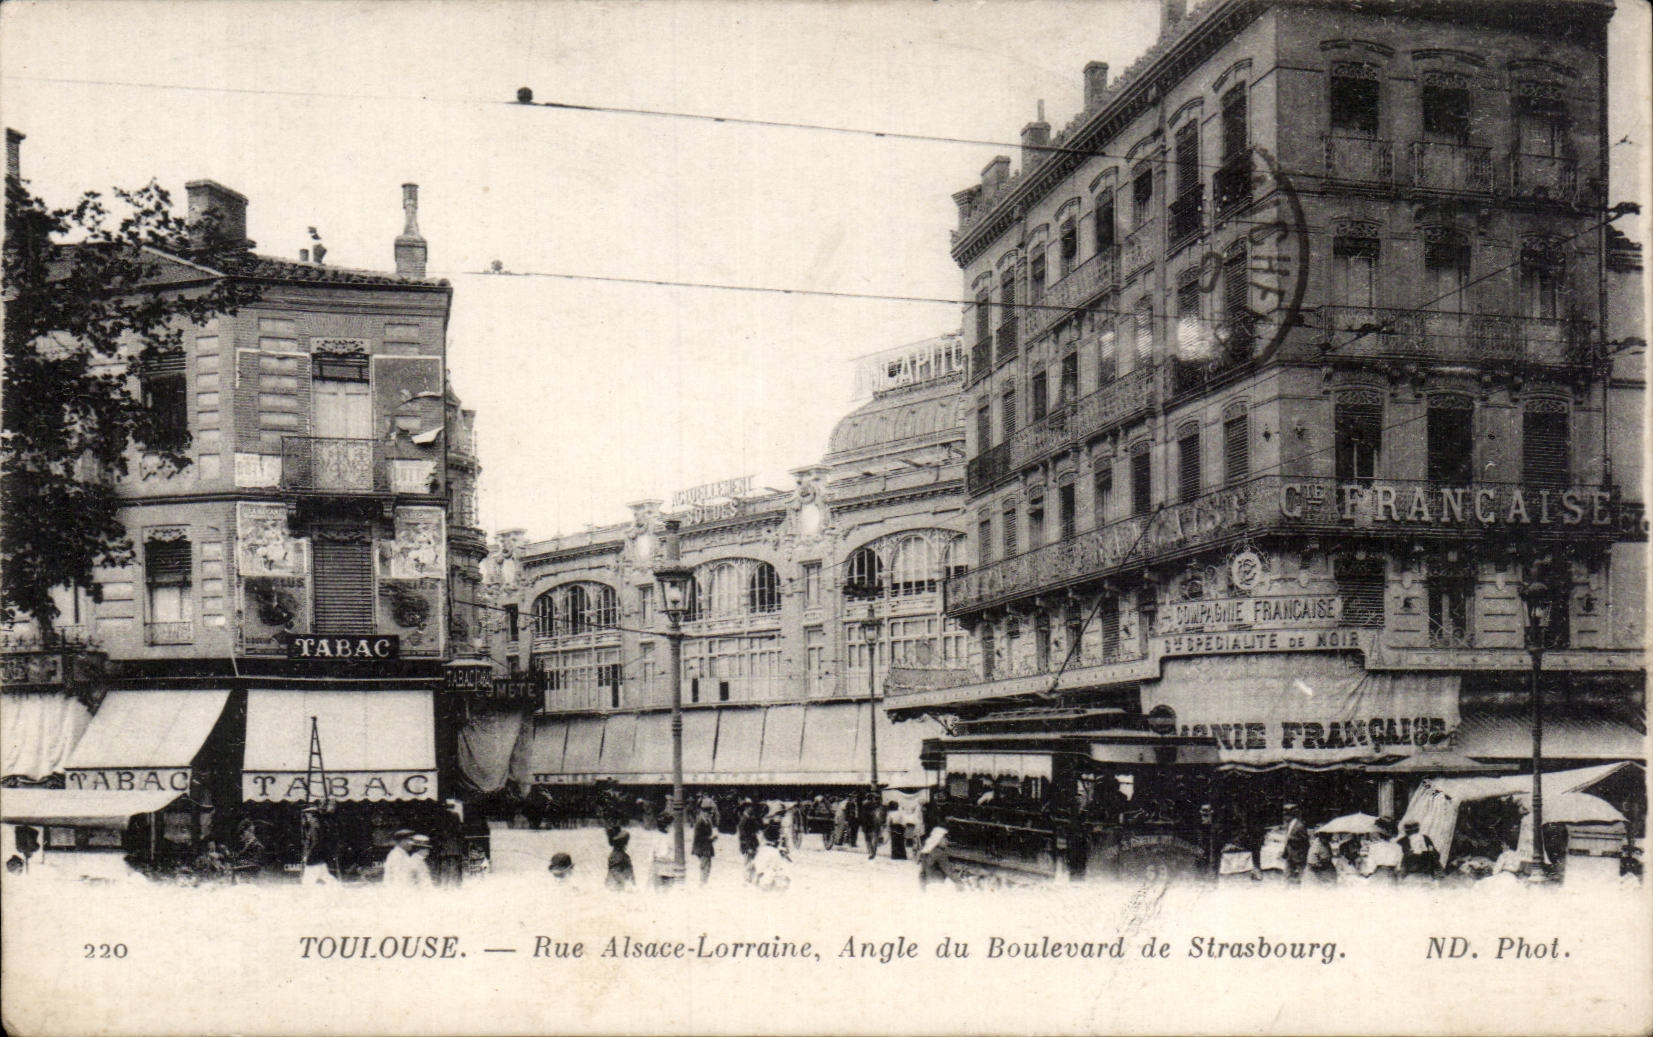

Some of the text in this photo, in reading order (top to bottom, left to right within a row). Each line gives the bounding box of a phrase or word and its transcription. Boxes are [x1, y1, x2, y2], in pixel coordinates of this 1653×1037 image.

[1176, 601, 1244, 626] COMPAGNIE
[295, 637, 390, 658] TABAC
[1316, 631, 1359, 647] NOIR
[446, 670, 475, 688] TABAC
[70, 769, 189, 792] TABAC
[252, 774, 429, 797] TABAC
